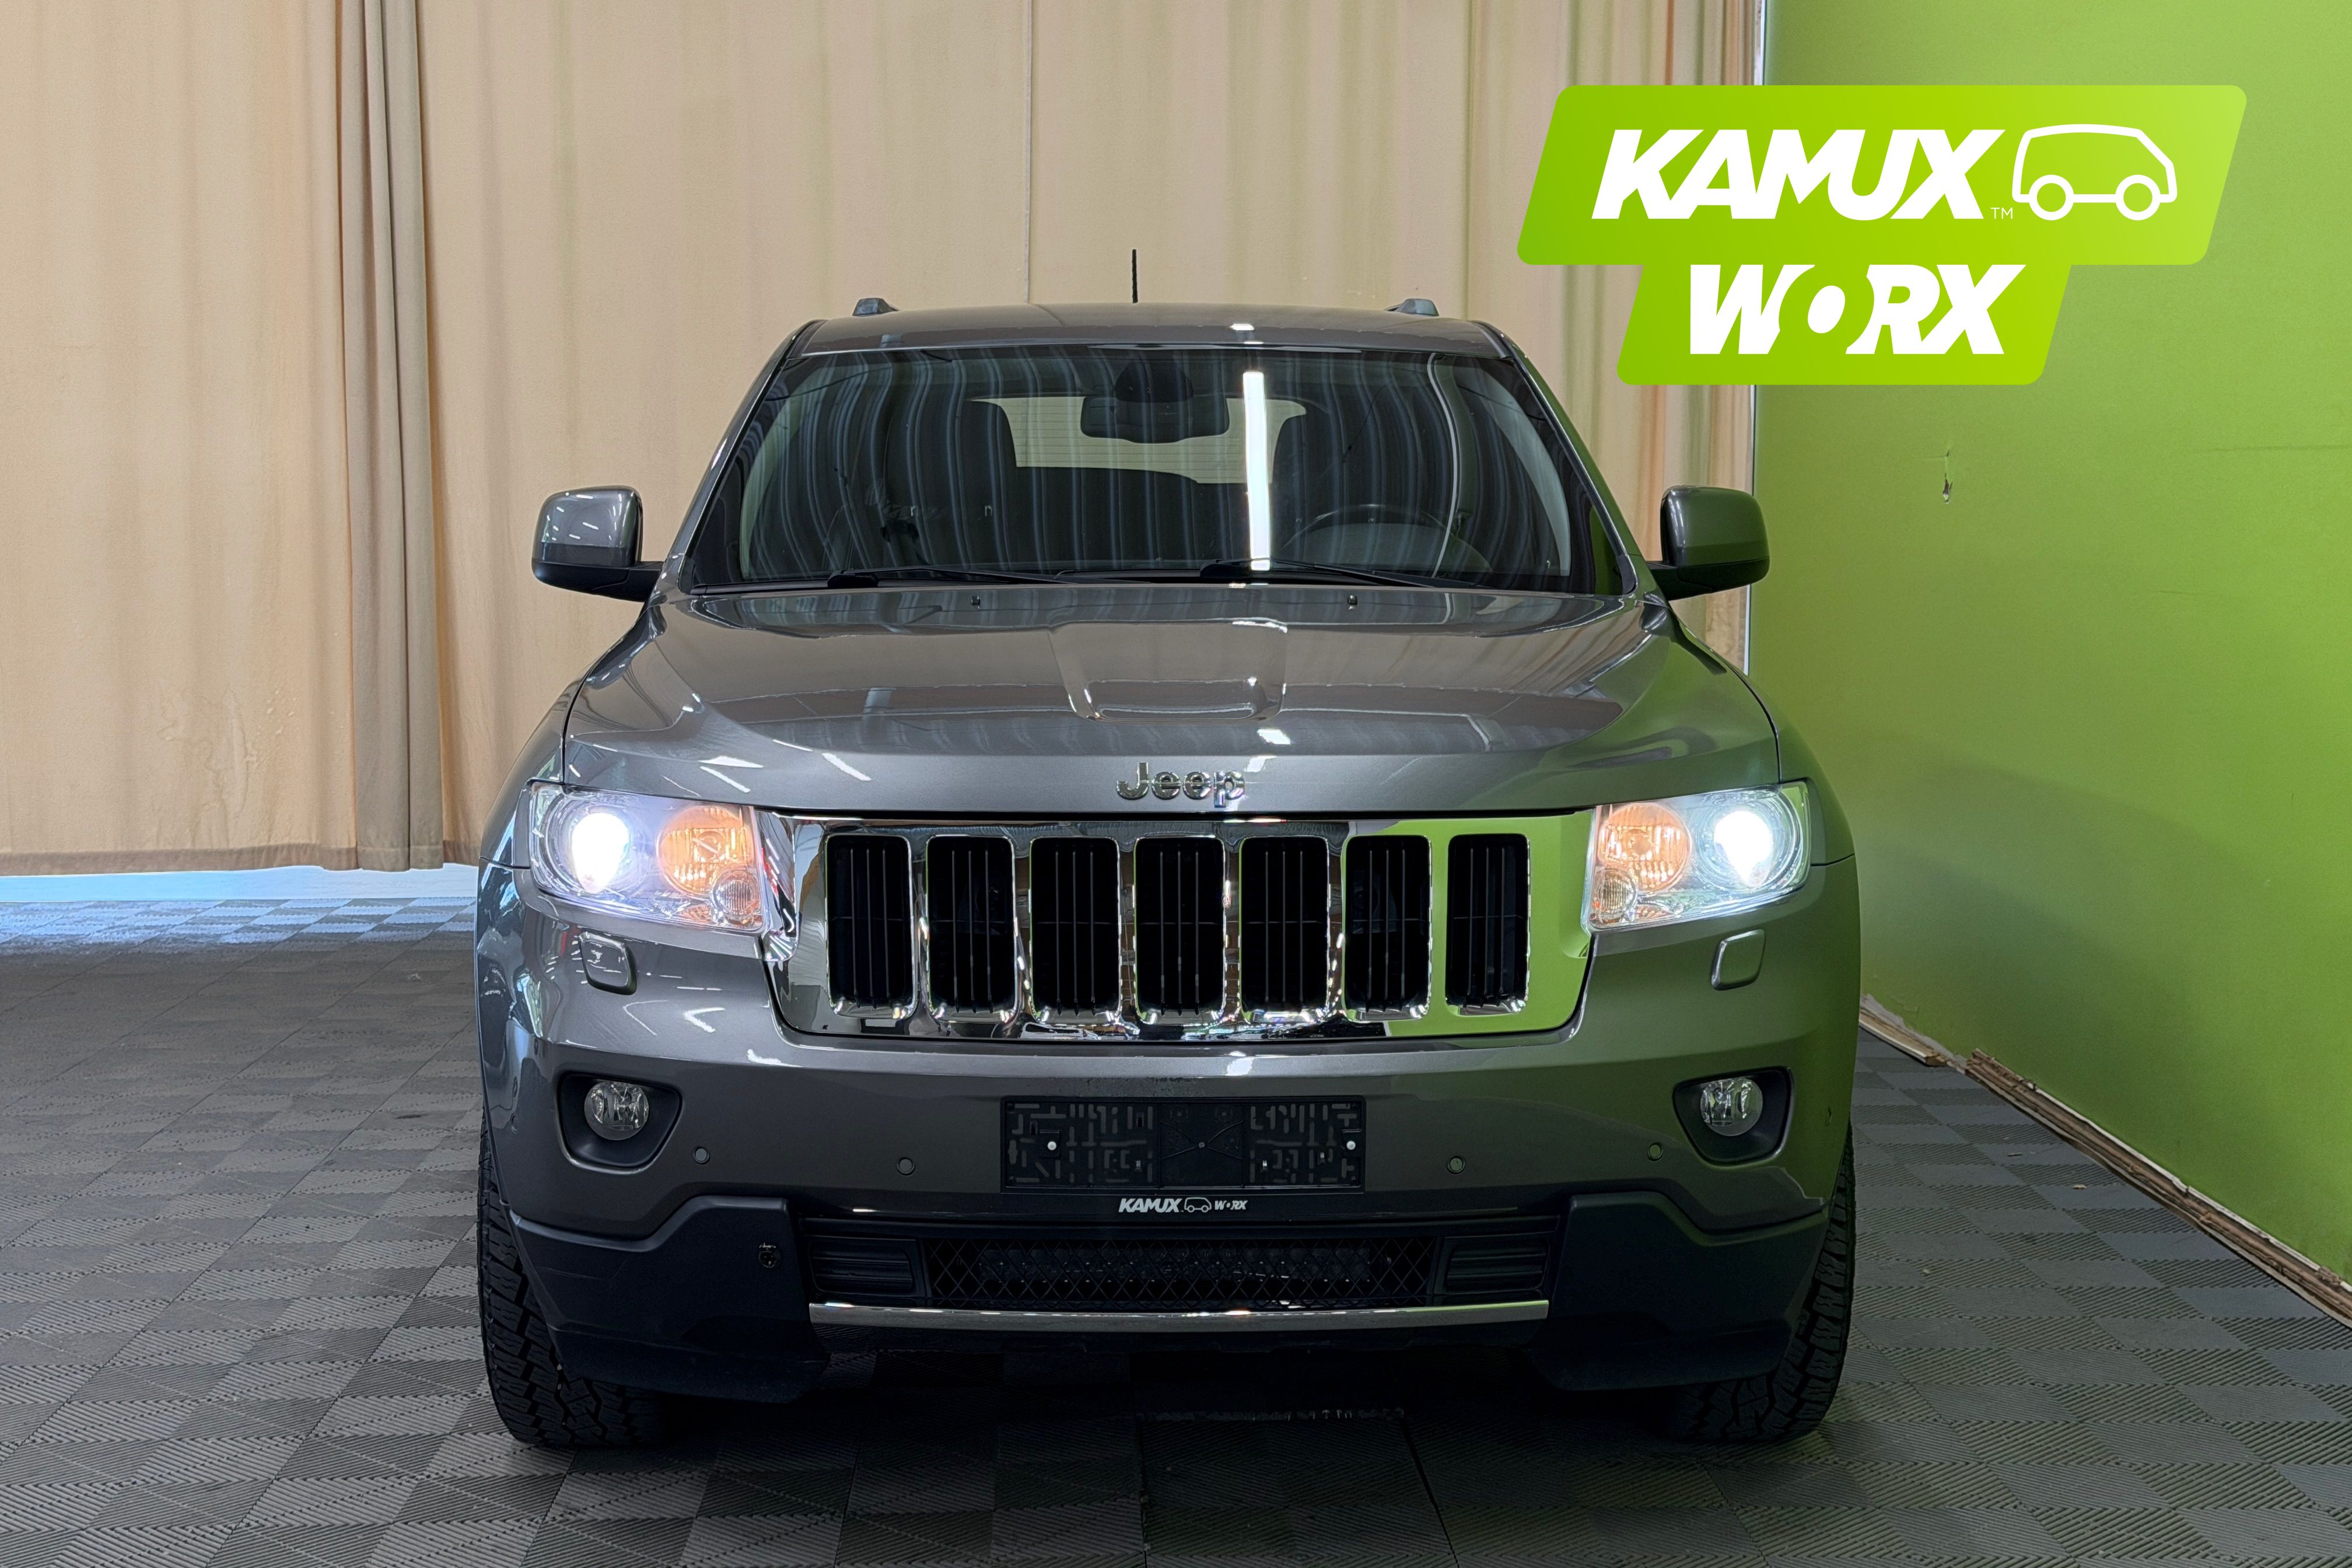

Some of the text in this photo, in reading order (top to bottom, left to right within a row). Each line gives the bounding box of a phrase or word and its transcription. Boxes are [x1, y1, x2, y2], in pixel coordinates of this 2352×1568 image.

[1115, 762, 1245, 808] Jeep
[1118, 1198, 1249, 1213] KAMUX WORX
